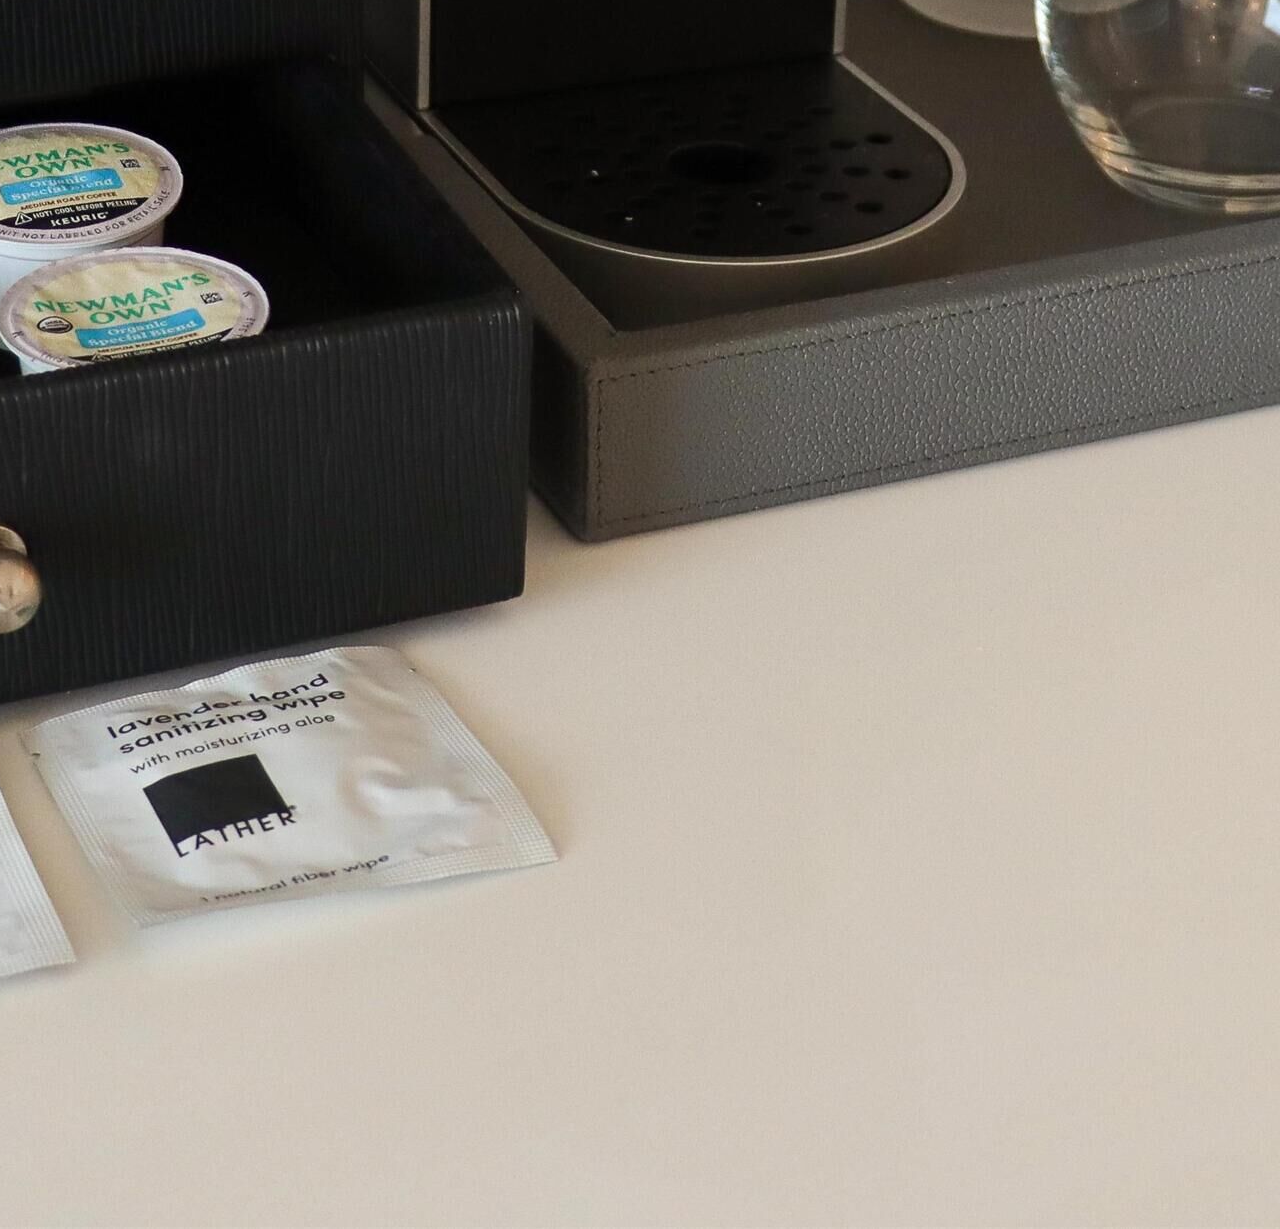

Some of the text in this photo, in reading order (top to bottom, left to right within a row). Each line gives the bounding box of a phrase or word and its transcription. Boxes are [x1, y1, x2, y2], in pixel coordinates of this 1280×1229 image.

[15, 157, 93, 178] OWN
[29, 174, 88, 188] Organic
[20, 190, 117, 211] MEDIUM ROAST COFFEE
[55, 206, 75, 216] COOL
[77, 202, 104, 212] BEFORE
[106, 198, 138, 208] PEELING
[22, 232, 45, 240] NOT
[50, 228, 102, 240] LABELED
[105, 218, 127, 232] FOR
[127, 205, 158, 224] RETAIL
[50, 212, 107, 227] KEURIG
[34, 272, 210, 314] NEWMAN'S
[89, 300, 171, 324] OWN
[88, 320, 199, 347] Special Blend
[107, 321, 169, 336] Organic
[107, 673, 331, 739] lavender hand
[119, 688, 347, 755] sanitizing wipe
[130, 713, 337, 775] with moisturizing aloe
[174, 809, 297, 859] LATHER
[214, 879, 288, 902] natural
[292, 868, 339, 886] fiber
[342, 854, 391, 874] wipe
